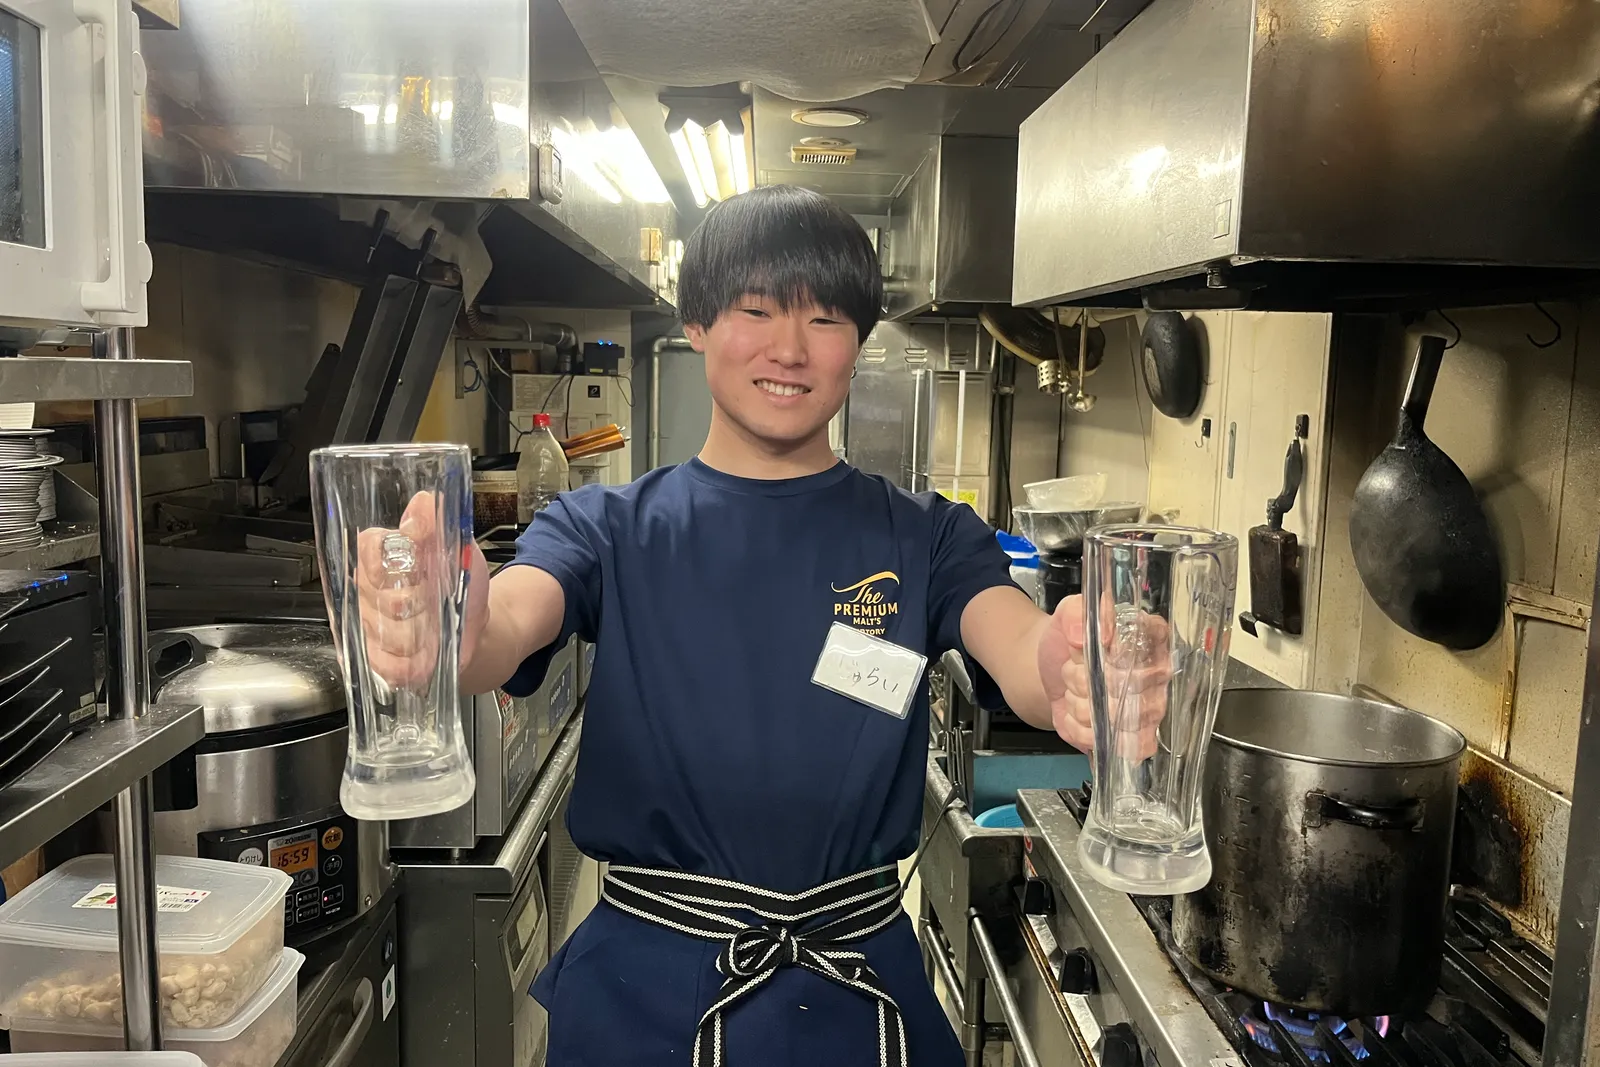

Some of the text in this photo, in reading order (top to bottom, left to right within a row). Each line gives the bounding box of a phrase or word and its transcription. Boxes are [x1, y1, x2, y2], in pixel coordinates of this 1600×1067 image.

[834, 602, 898, 617] PREMIUM
[853, 617, 881, 626] MALT'S
[239, 854, 262, 864] とりけし
[278, 847, 309, 867] 16:59
